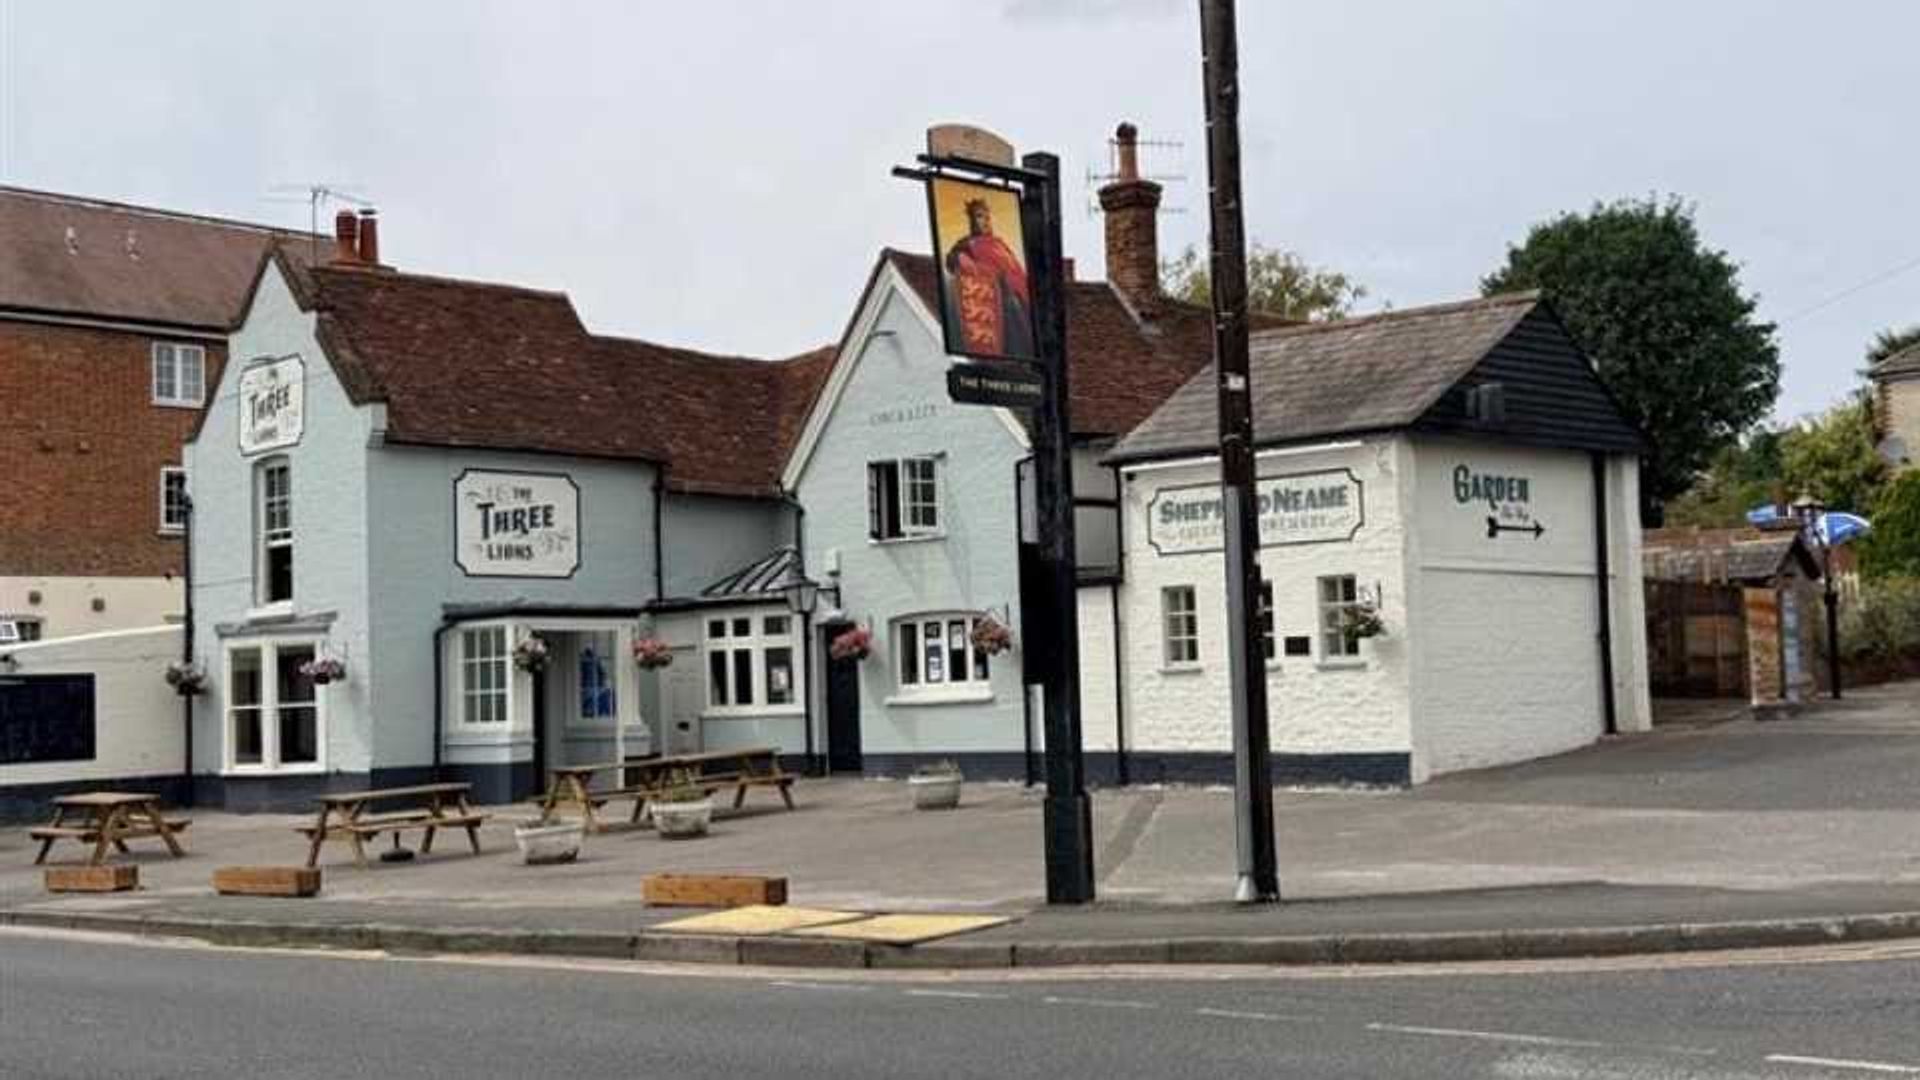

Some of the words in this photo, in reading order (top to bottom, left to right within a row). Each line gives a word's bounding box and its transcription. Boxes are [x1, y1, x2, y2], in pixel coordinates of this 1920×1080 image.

[248, 384, 290, 430] THREE
[1160, 493, 1272, 524] SHEPD
[1272, 485, 1349, 514] NEAME
[1453, 463, 1529, 511] GARDEN
[476, 501, 556, 541] THREE
[487, 543, 536, 562] LIONS
